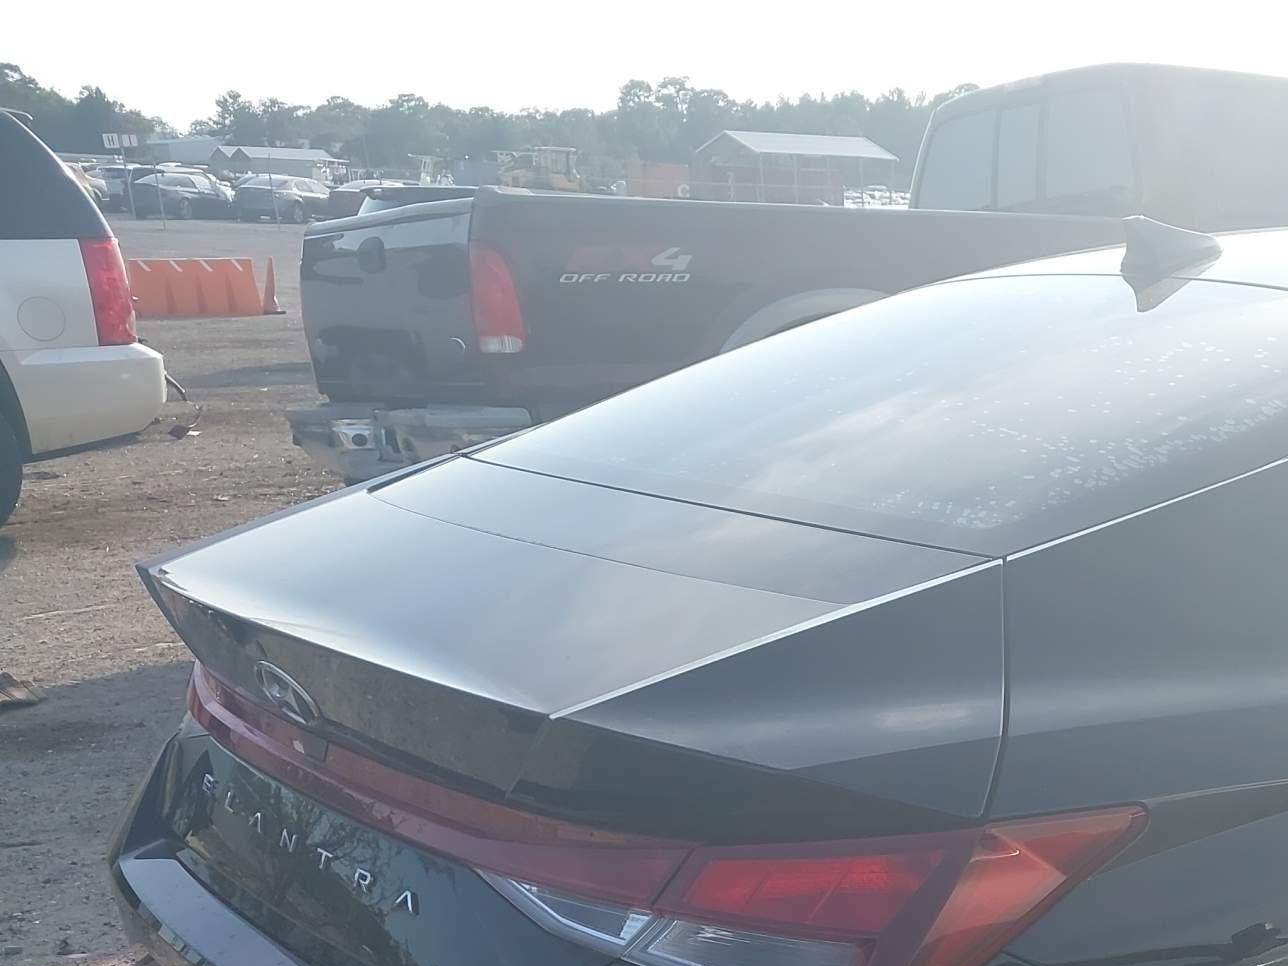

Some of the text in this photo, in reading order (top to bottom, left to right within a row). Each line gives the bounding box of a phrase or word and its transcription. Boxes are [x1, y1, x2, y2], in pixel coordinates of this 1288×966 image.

[559, 273, 691, 283] OFF ROAD
[202, 773, 414, 913] ELANTRA
